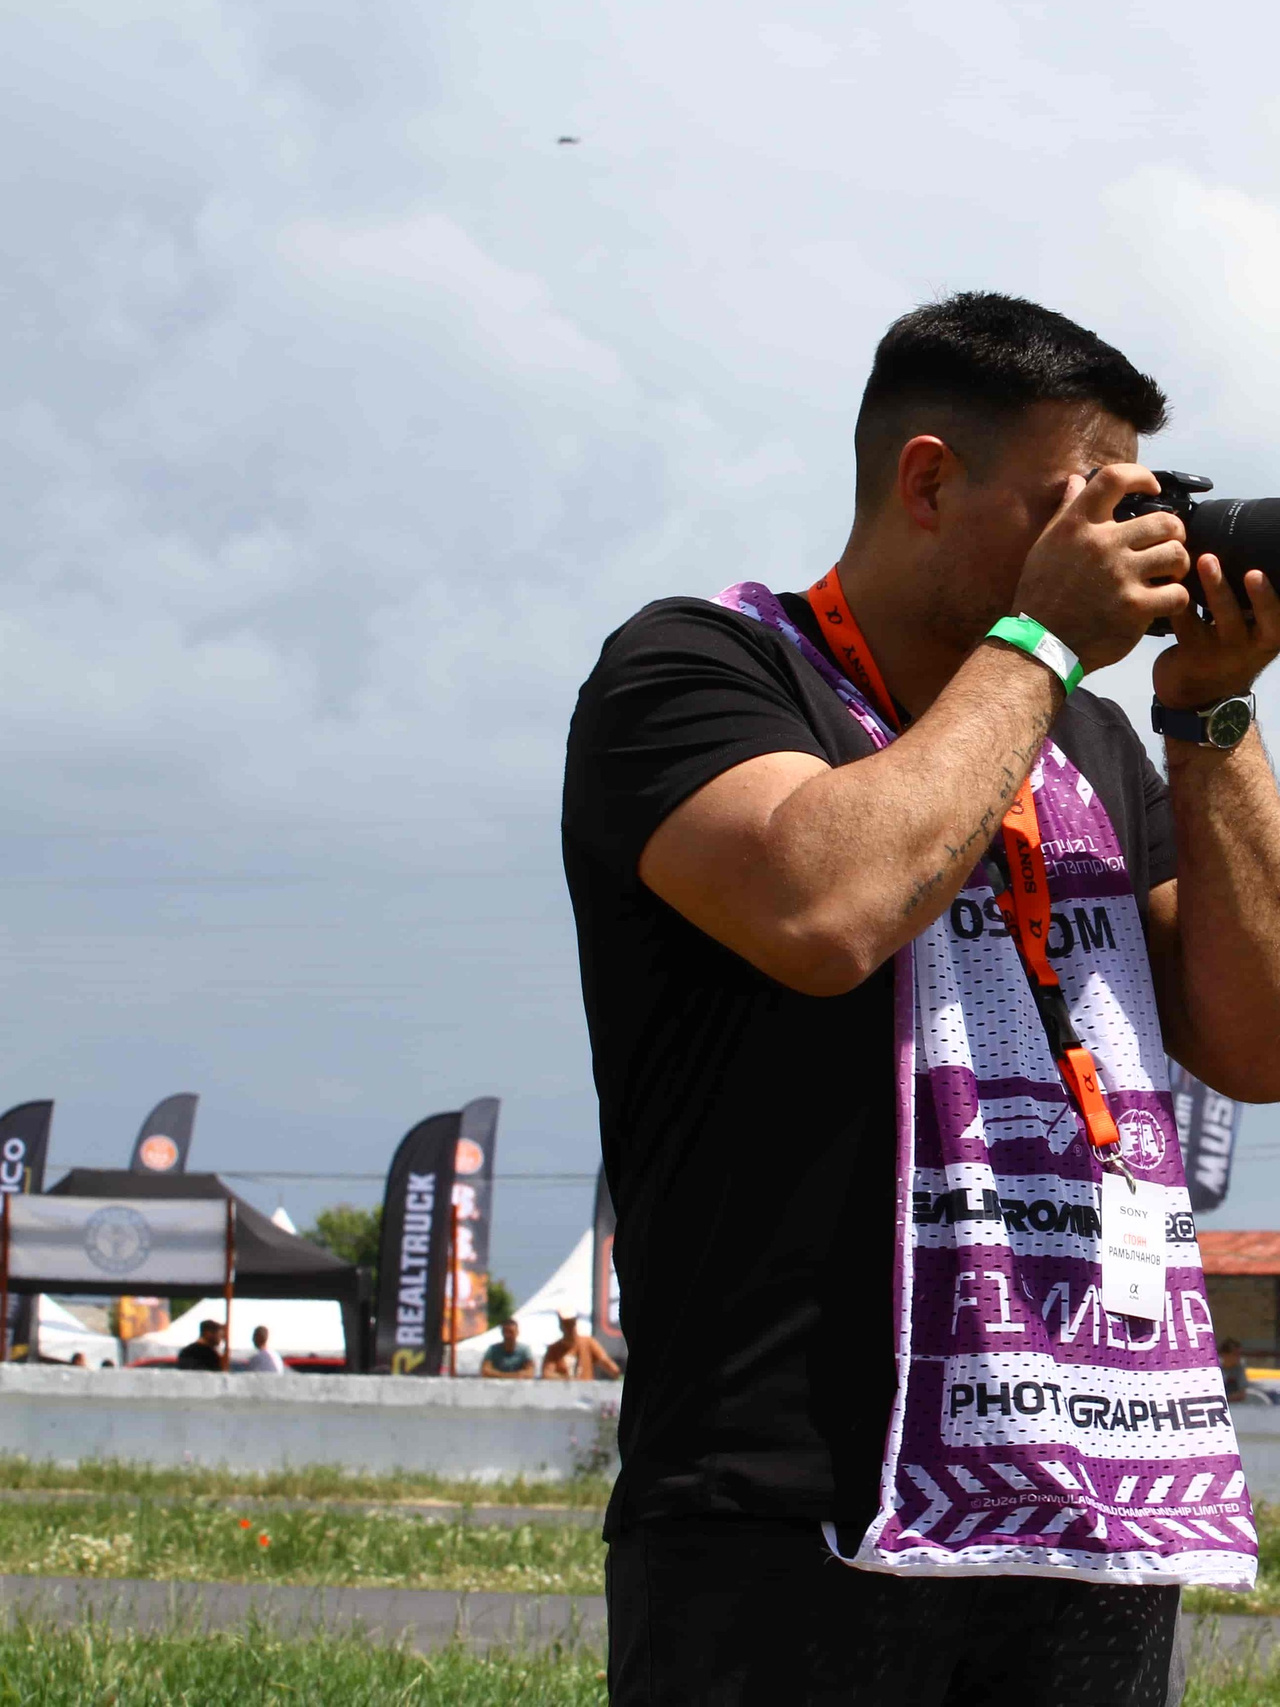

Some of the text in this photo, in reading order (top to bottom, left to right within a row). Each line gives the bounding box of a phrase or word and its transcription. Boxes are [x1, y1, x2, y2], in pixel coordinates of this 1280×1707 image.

[1017, 838, 1038, 894] SONY
[1119, 1206, 1148, 1219] SONY
[397, 1172, 435, 1346] REALTRUCK
[1108, 1246, 1161, 1266] РАМЪЛЧАНОВ
[1123, 1234, 1147, 1248] СТОЯН
[950, 1271, 1025, 1336] F1
[951, 1381, 1231, 1432] PHOTGRAPHER
[1019, 1493, 1086, 1505] FORMULA
[1193, 1503, 1240, 1516] LIMITED
